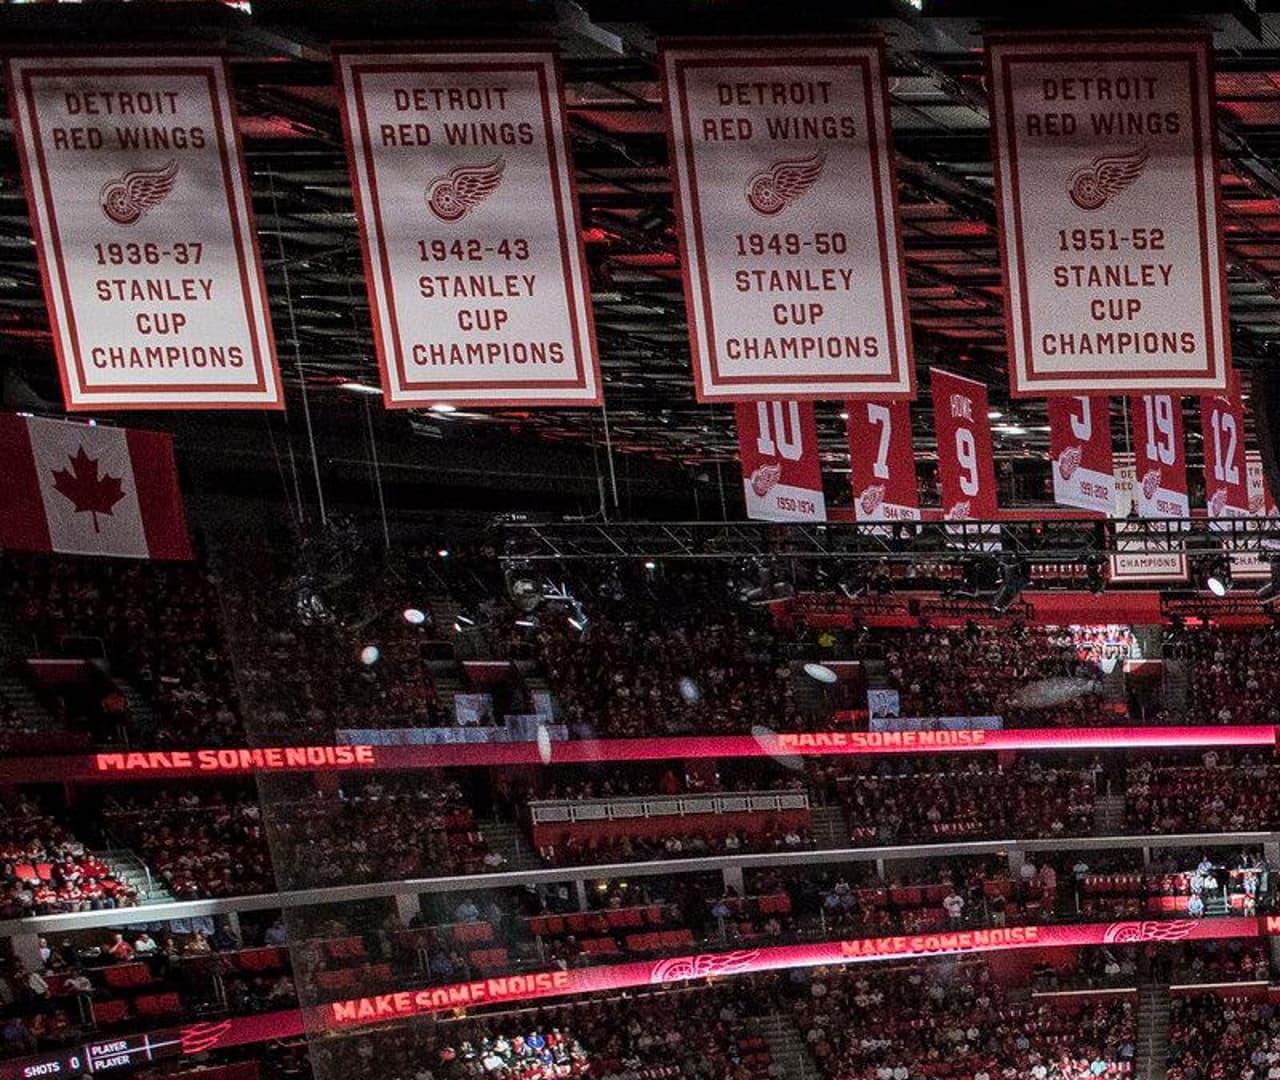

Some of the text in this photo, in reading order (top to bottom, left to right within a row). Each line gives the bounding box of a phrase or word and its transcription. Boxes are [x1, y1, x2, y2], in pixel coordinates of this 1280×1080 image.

[394, 87, 509, 111] DETROIT
[717, 81, 832, 106] DETROIT
[1043, 77, 1159, 101] DETROIT
[64, 91, 179, 115] DETROIT
[380, 122, 534, 147] RED WINGS
[703, 117, 857, 141] RED WINGS
[1026, 112, 1180, 136] RED WINGS
[53, 126, 205, 151] RED WINGS
[417, 238, 531, 262] 1942-43
[735, 232, 848, 256] 1949-50
[1058, 228, 1165, 251] 1951-52
[94, 242, 203, 265] 1936-37
[418, 274, 537, 298] STANLEY
[735, 268, 853, 292] STANLEY
[1054, 263, 1173, 287] STANLEY
[95, 279, 213, 302] STANLEY
[458, 309, 509, 332] CUP
[773, 303, 824, 326] CUP
[1090, 299, 1141, 321] CUP
[136, 312, 187, 335] CUP
[412, 342, 565, 365] CHAMPIONS
[725, 336, 879, 360] CHAMPIONS
[1042, 332, 1196, 355] CHAMPIONS
[91, 345, 244, 369] CHAMPIONS
[756, 400, 803, 462] 10
[867, 403, 892, 479] 7
[1143, 395, 1176, 466] 19
[1211, 409, 1239, 485] 12
[955, 427, 979, 497] 9
[1119, 557, 1178, 569] CHAMPIONS
[332, 971, 569, 1022] MAKE SOME NOISE
[92, 1041, 128, 1056] PLAYER
[24, 1062, 60, 1077] SHOTS
[95, 1056, 130, 1070] PLAYER
